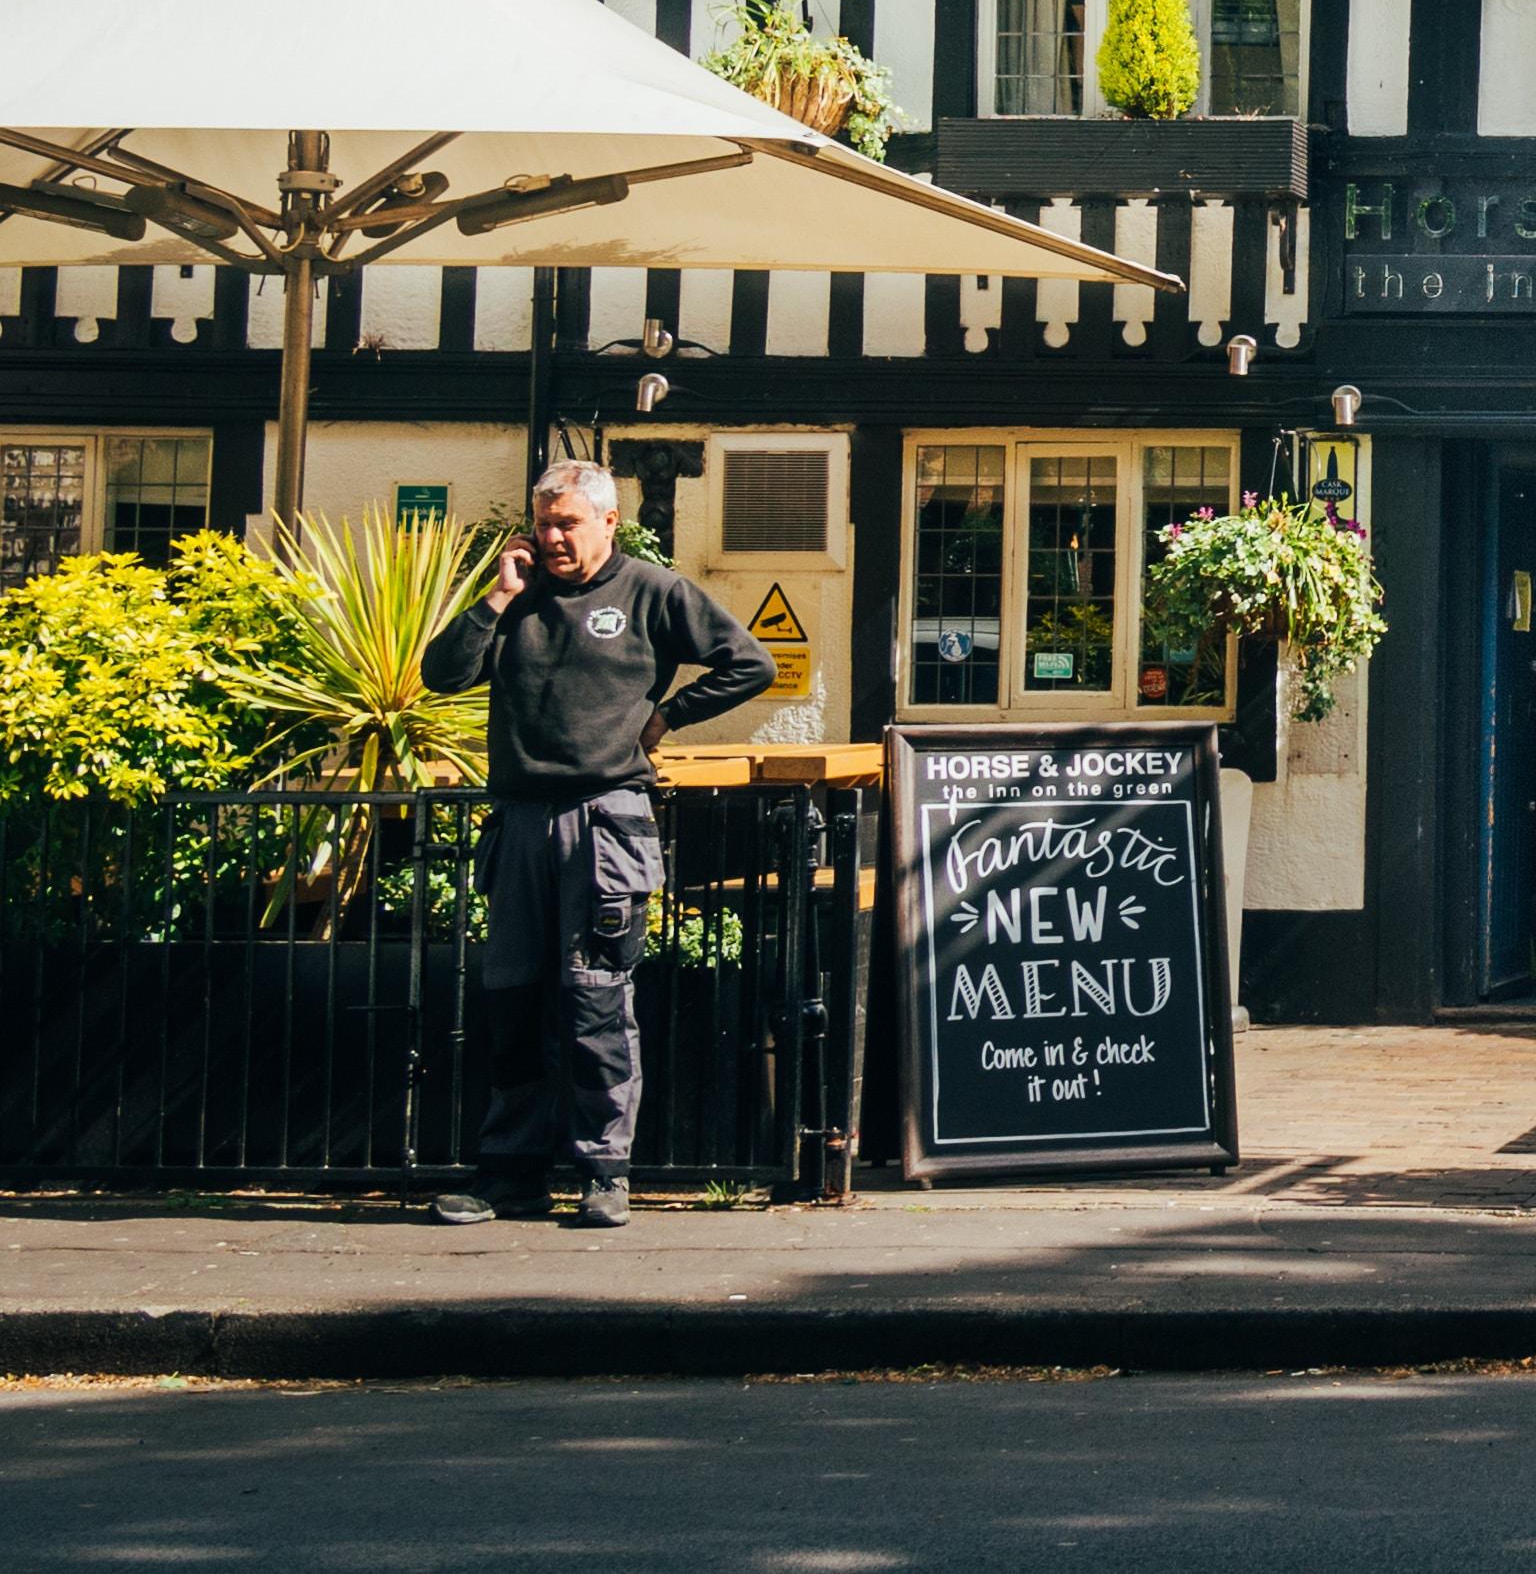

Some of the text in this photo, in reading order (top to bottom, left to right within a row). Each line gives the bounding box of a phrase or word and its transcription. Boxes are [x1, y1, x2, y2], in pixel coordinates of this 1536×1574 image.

[1354, 263, 1444, 300] the
[926, 751, 1183, 780] HORSE & JOCKEY
[942, 780, 1173, 800] the inn on the green
[986, 885, 1108, 945] NEW
[946, 957, 1173, 1023] MENU
[981, 1034, 1156, 1071] Come in & check
[1027, 1075, 1046, 1103] it
